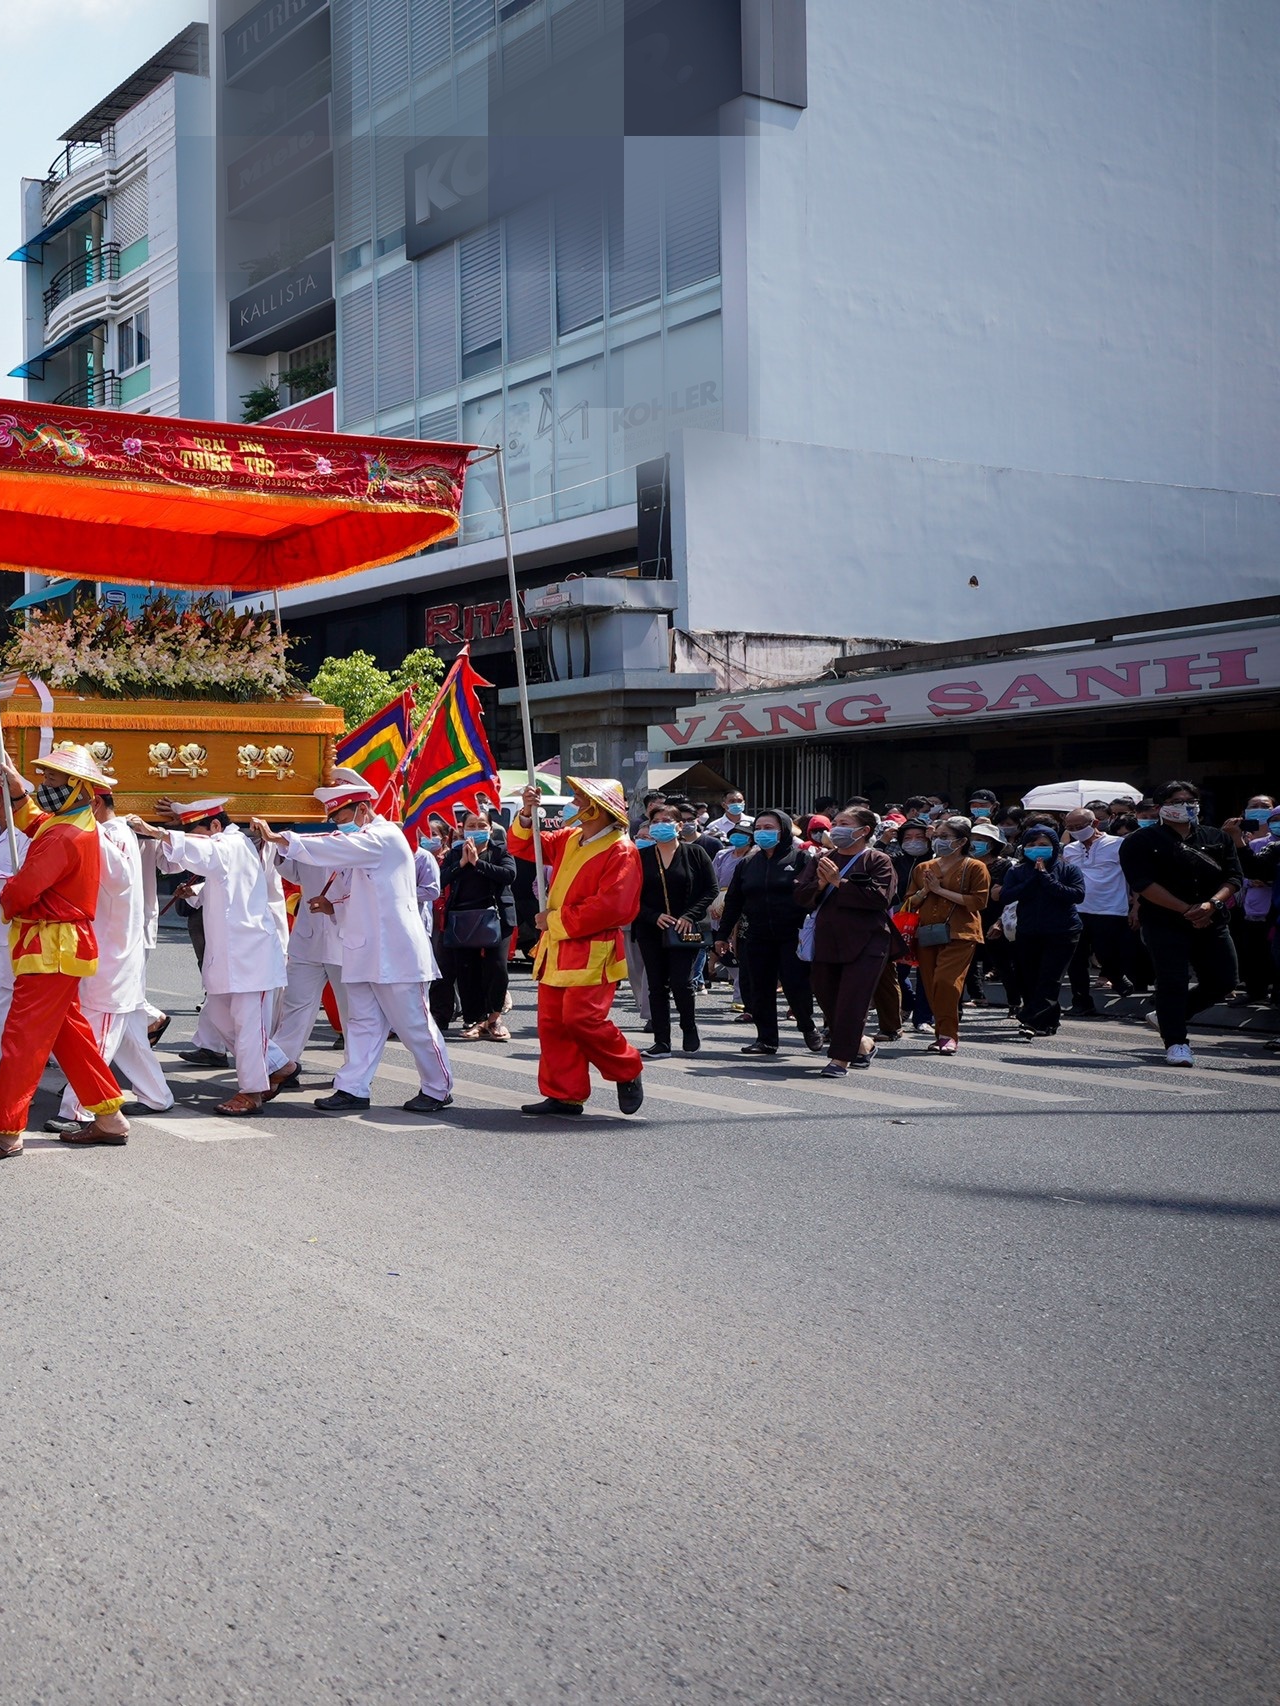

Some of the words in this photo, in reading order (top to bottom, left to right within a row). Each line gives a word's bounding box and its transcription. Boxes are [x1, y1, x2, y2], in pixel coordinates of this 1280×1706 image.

[239, 130, 315, 190] Miele
[240, 273, 317, 327] KALLISTA
[657, 693, 892, 746] VÃNG
[927, 647, 1260, 718] SANH
